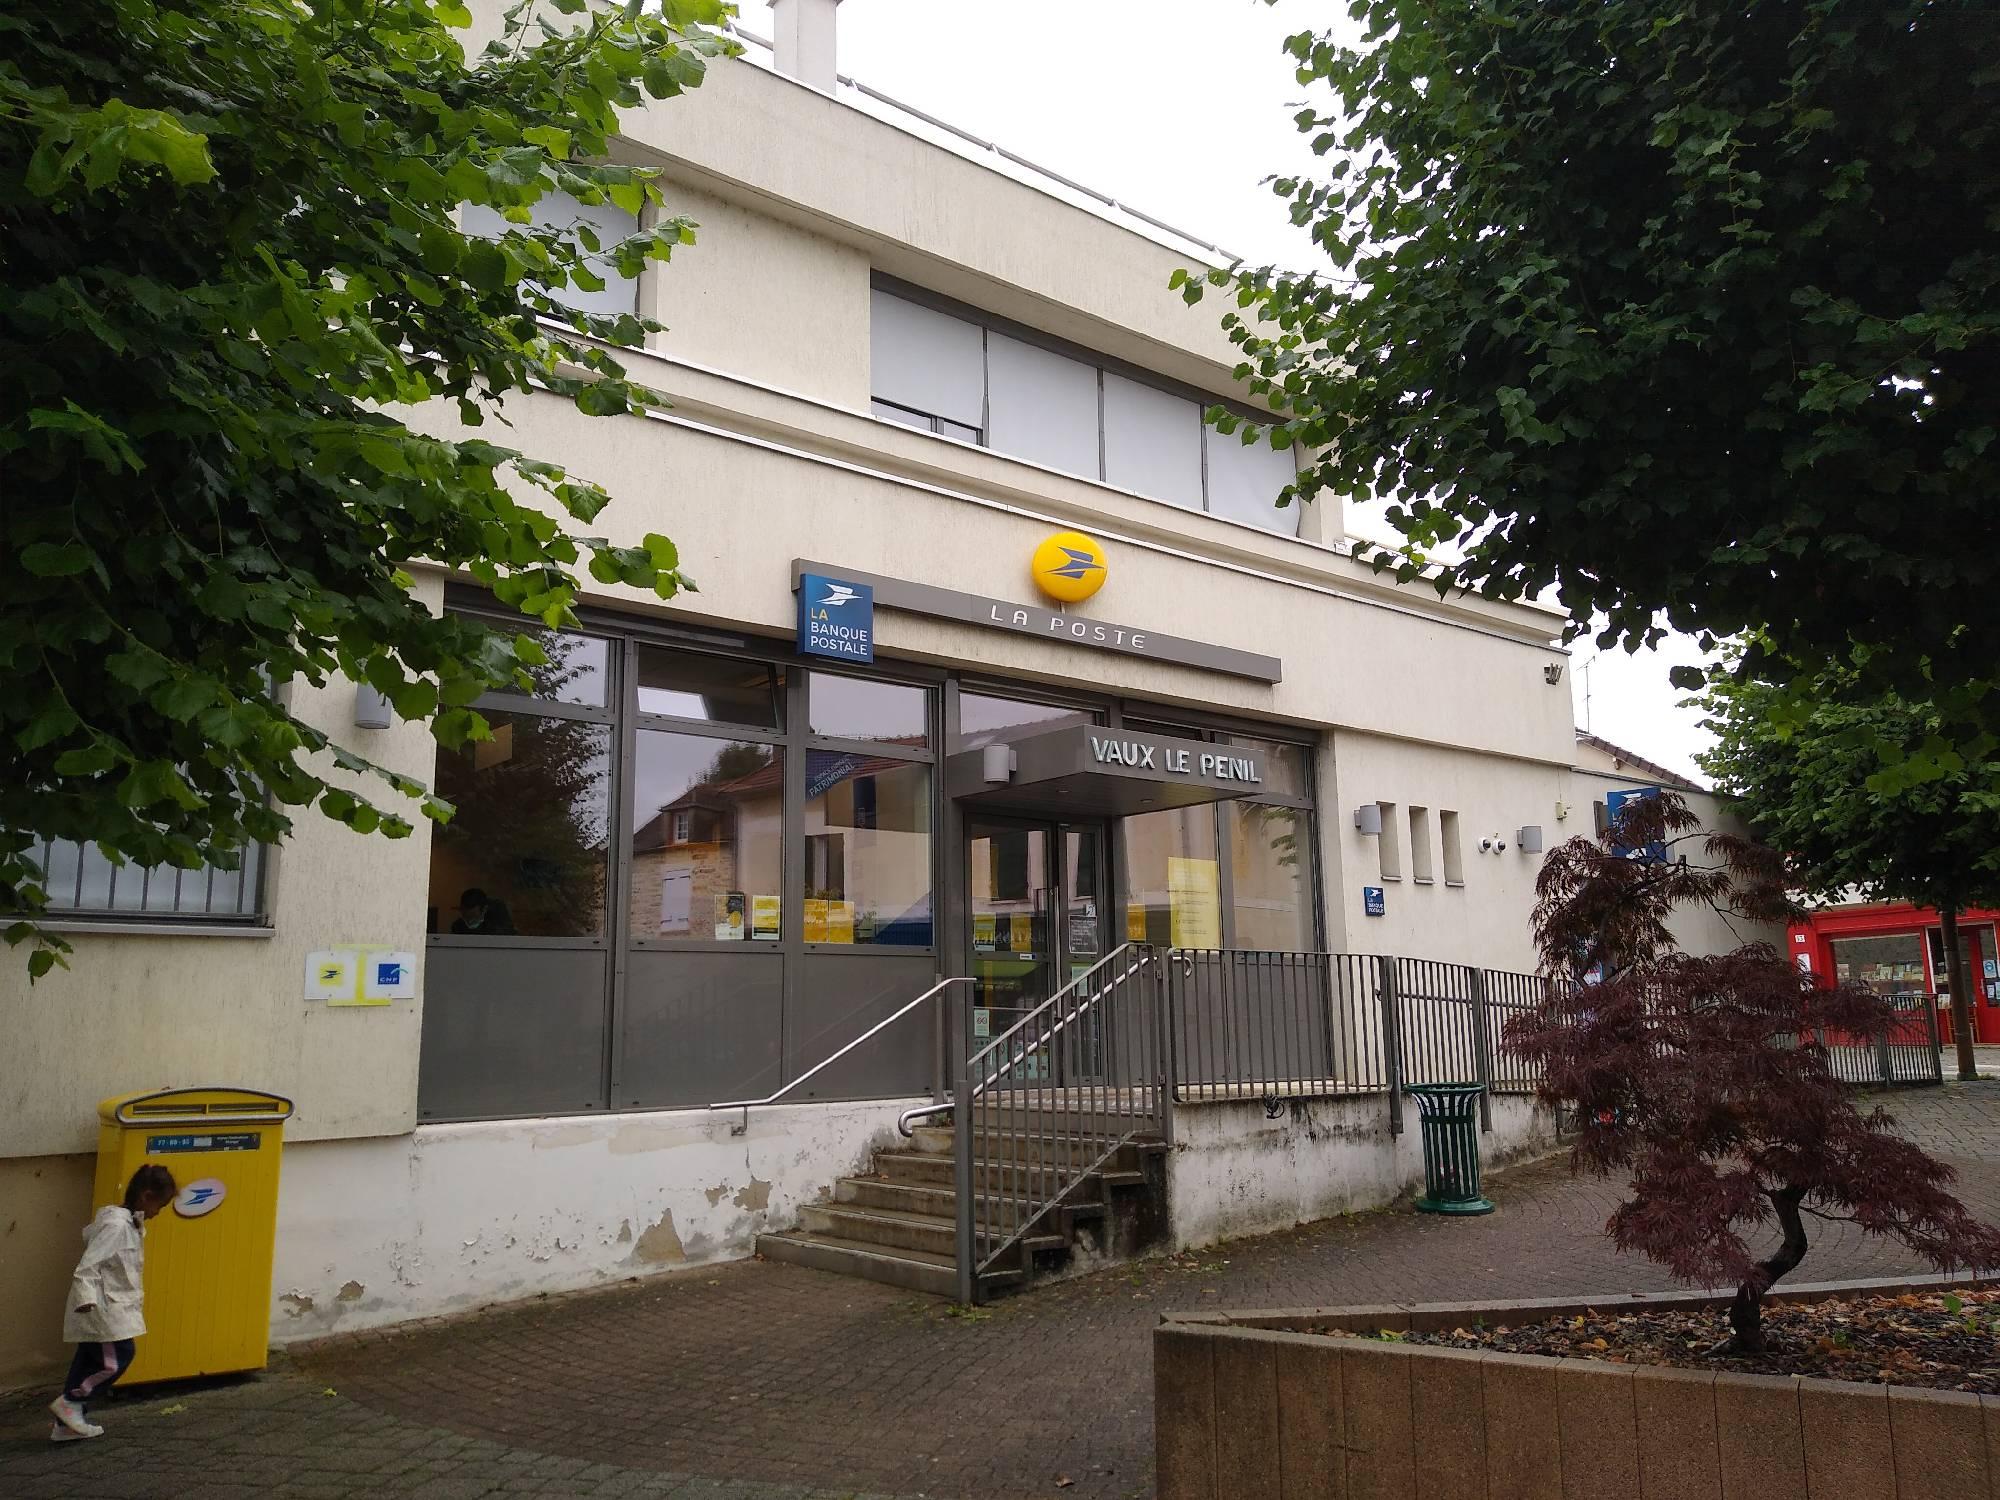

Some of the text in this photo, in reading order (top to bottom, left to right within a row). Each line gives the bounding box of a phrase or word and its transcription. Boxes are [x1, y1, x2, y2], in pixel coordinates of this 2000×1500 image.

[810, 607, 829, 621] LA
[991, 604, 1146, 649] LA POSTE
[810, 621, 868, 642] BANQUE
[810, 635, 868, 656] POSTALE
[1090, 736, 1263, 783] VAUX LE PENIL
[809, 761, 855, 797] PATRIMONIAL
